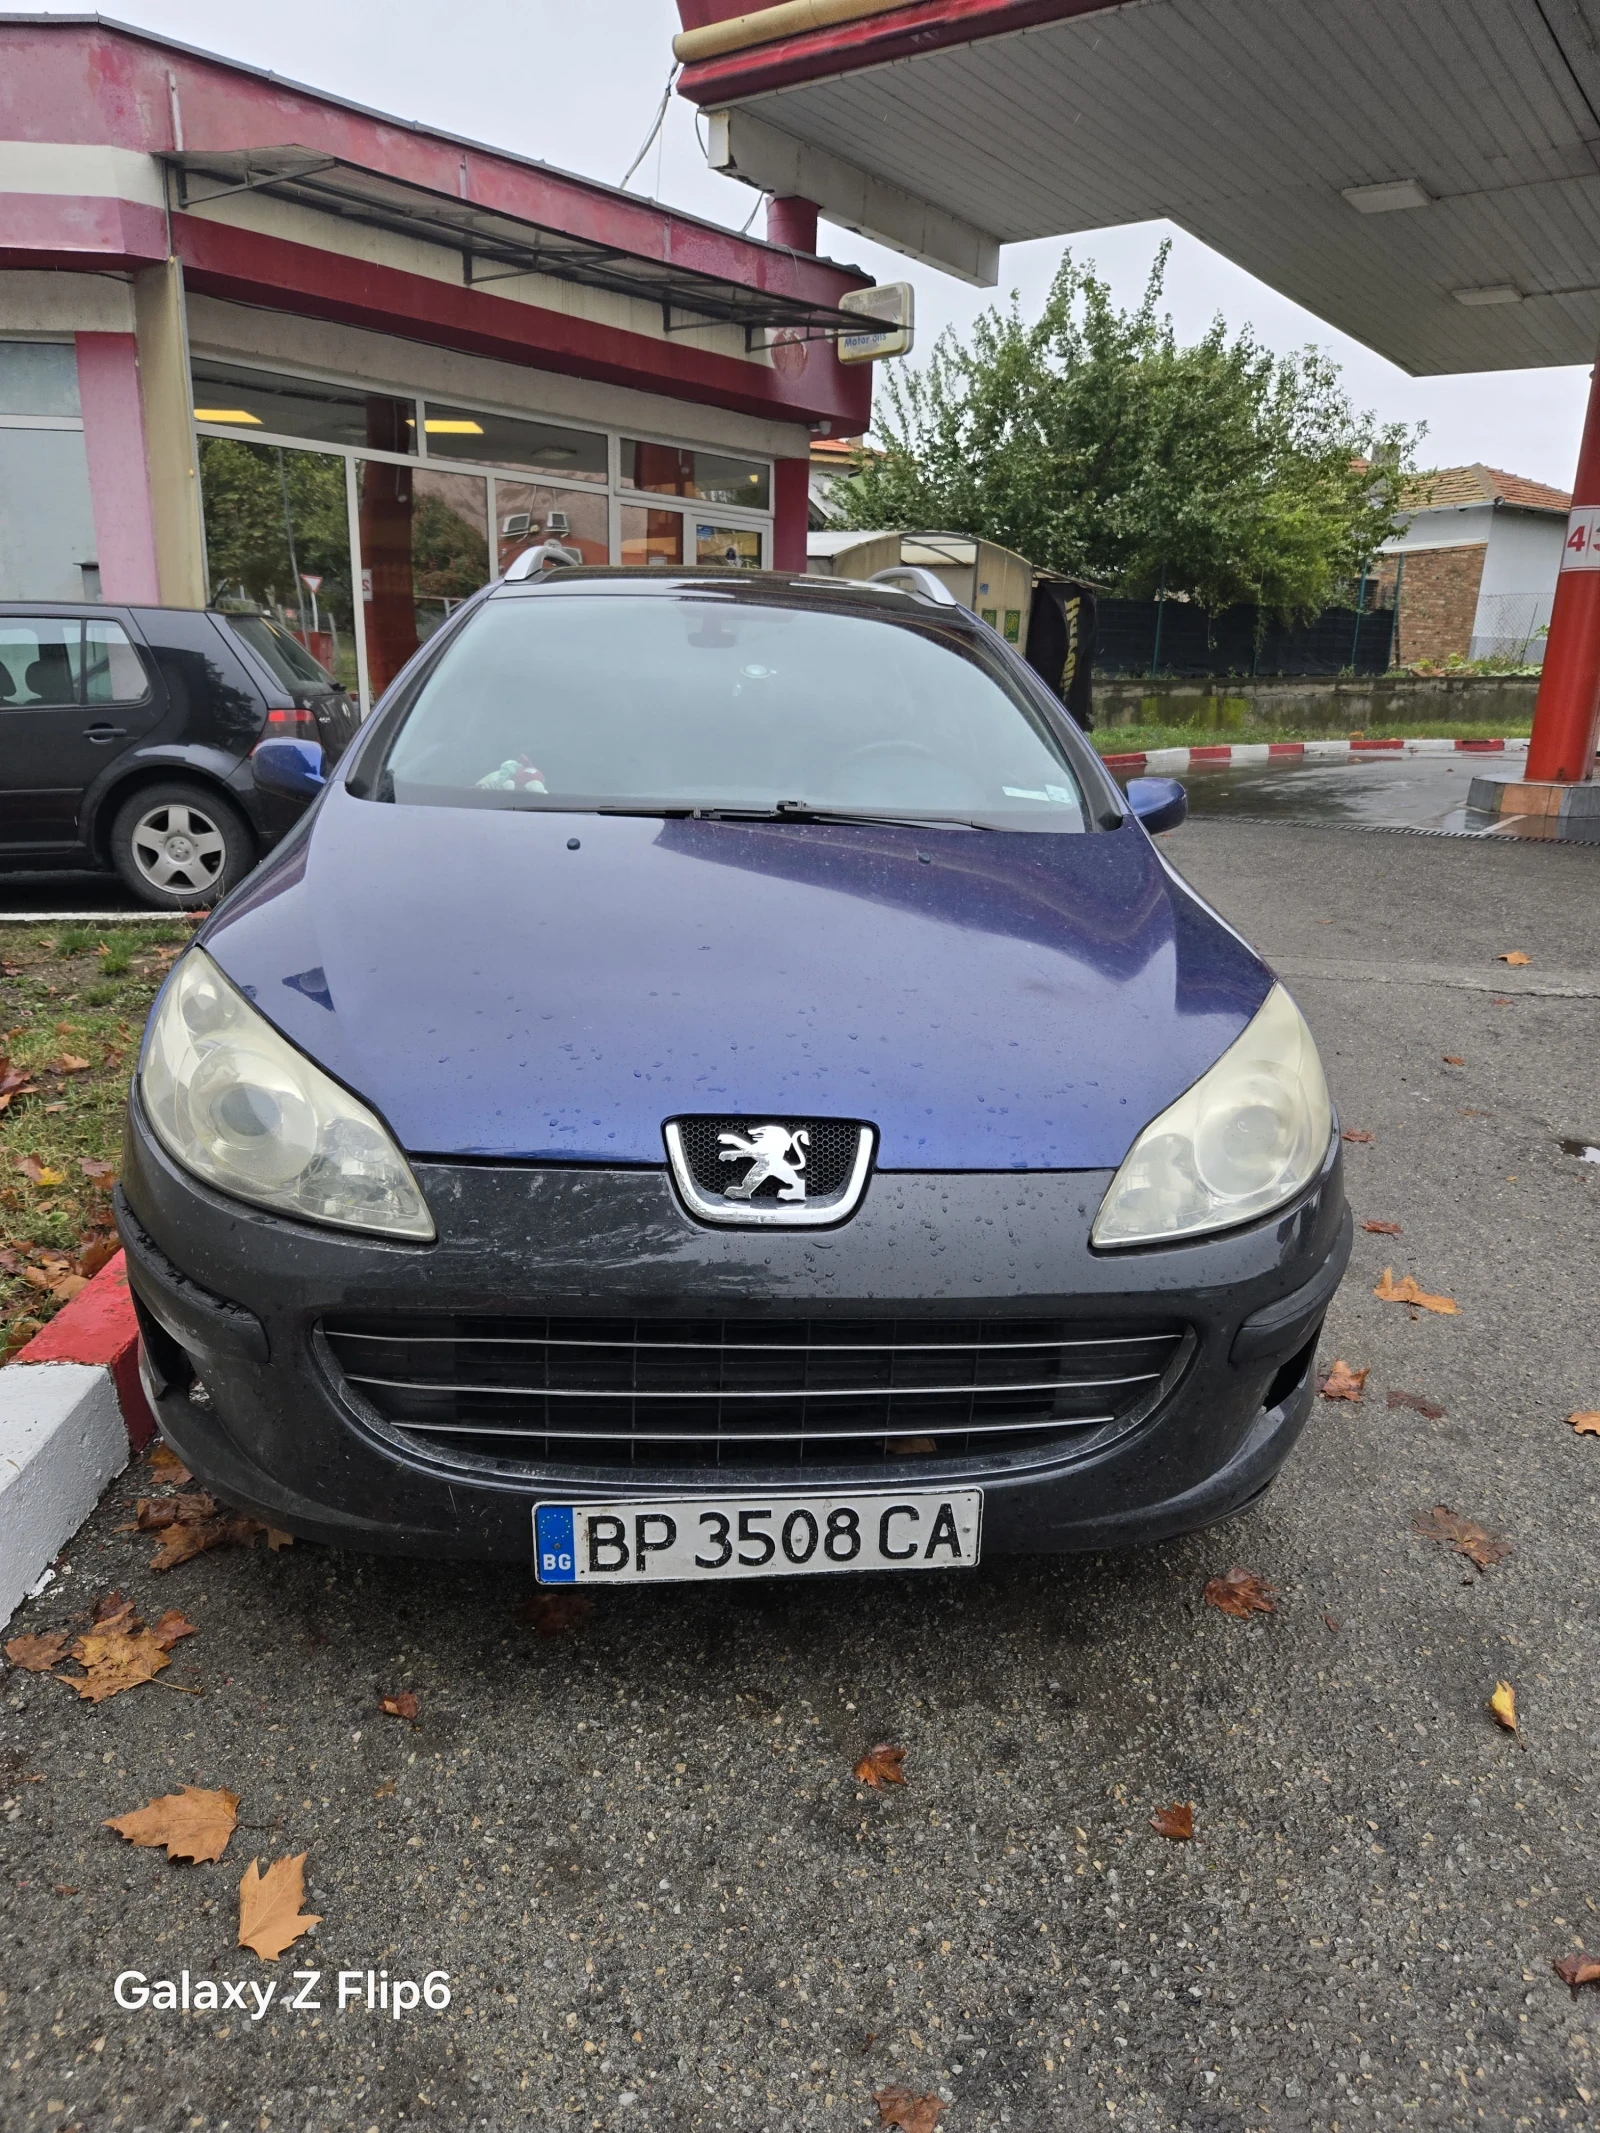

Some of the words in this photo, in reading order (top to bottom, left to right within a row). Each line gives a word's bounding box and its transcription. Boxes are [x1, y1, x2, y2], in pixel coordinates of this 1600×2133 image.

[844, 336, 870, 348] Motor
[1567, 525, 1586, 552] 4
[588, 1513, 677, 1573] BP
[694, 1507, 862, 1570] 3508
[878, 1502, 963, 1561] CA
[543, 1554, 572, 1572] BG
